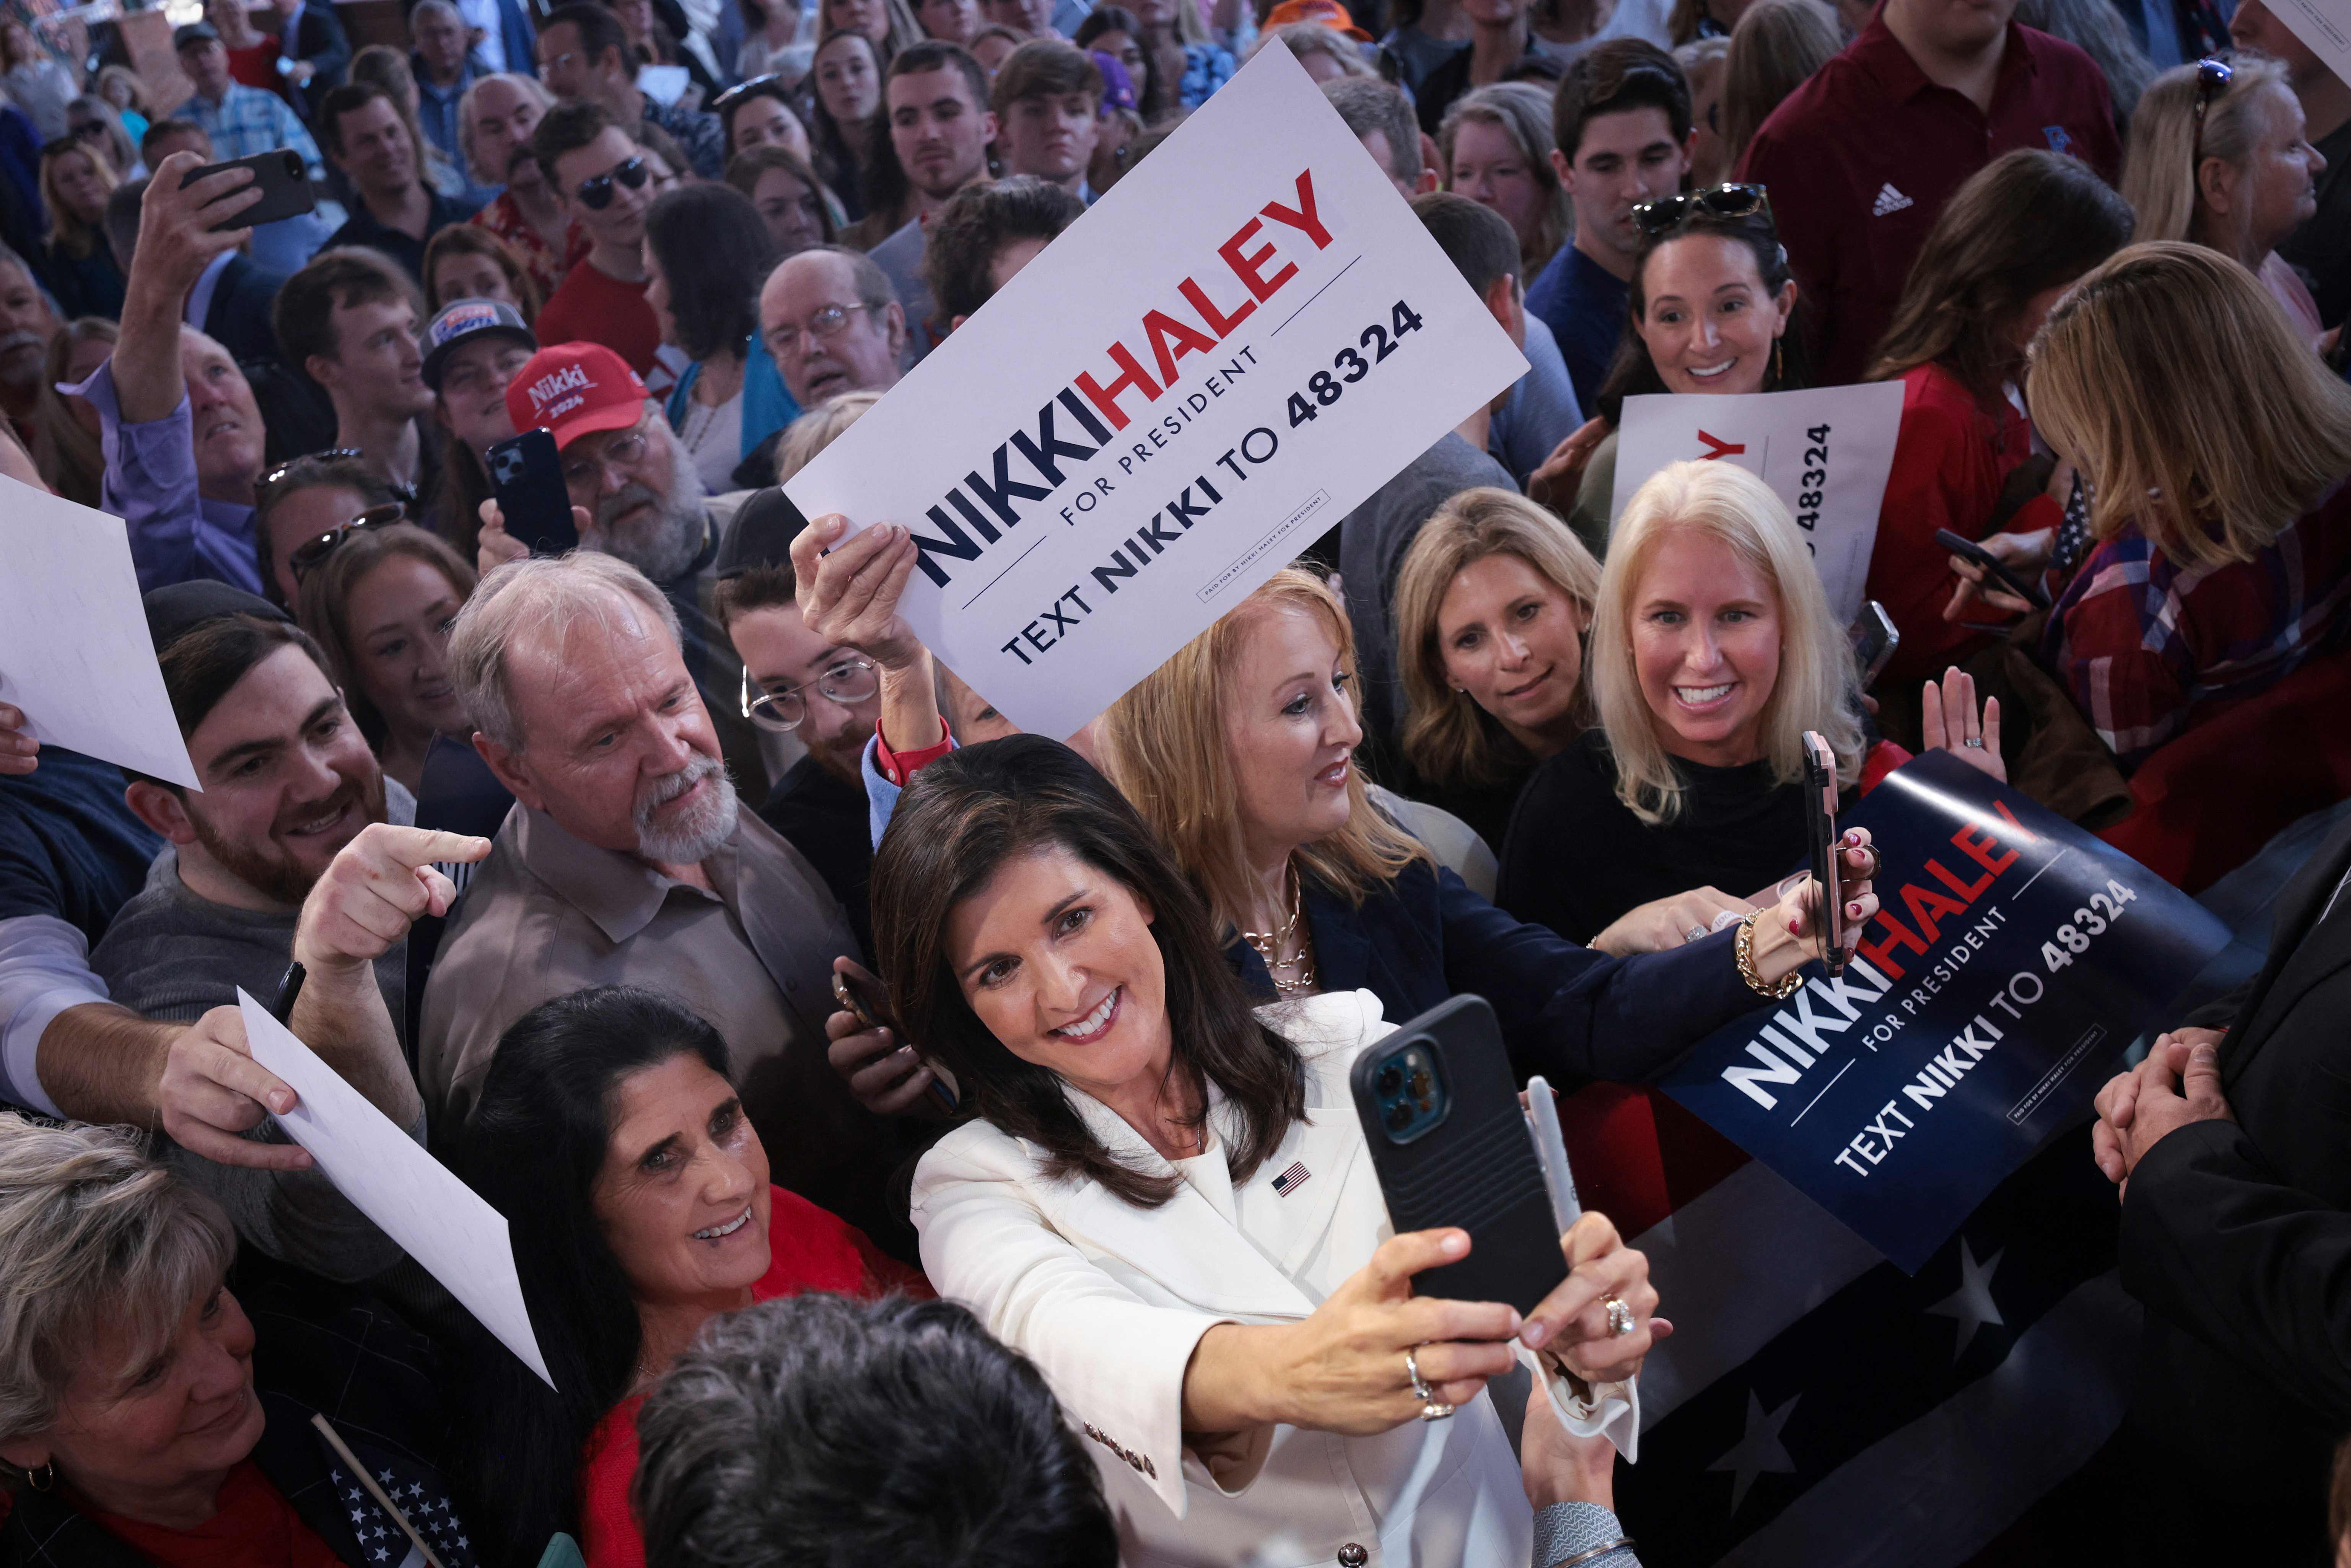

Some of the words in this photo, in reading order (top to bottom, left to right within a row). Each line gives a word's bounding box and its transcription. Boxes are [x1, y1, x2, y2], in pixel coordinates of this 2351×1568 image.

[528, 364, 589, 410] Nikki
[549, 394, 584, 420] 2024
[1060, 477, 1116, 526] FOR
[1118, 345, 1257, 475] PRESIDENT
[1000, 584, 1092, 665] TEXT
[1090, 475, 1223, 594] NIKKI
[1216, 427, 1278, 481] TO
[1287, 300, 1423, 429] 48324
[1797, 424, 1831, 531] 48324
[1205, 583, 1219, 595] PAID
[1219, 573, 1232, 584] FOR
[1241, 550, 1259, 566] NIKKI
[1259, 534, 1277, 551] HALEY
[1278, 524, 1290, 535] FOR
[1291, 497, 1321, 524] PRESIDENT
[1834, 1099, 1915, 1177] TEXT
[1902, 1014, 2004, 1112] NIKKI
[1989, 971, 2044, 1020] TO
[2041, 879, 2138, 974] 48324
[1861, 1014, 1905, 1052] FOR
[1901, 905, 2006, 1015] PRESIDENT
